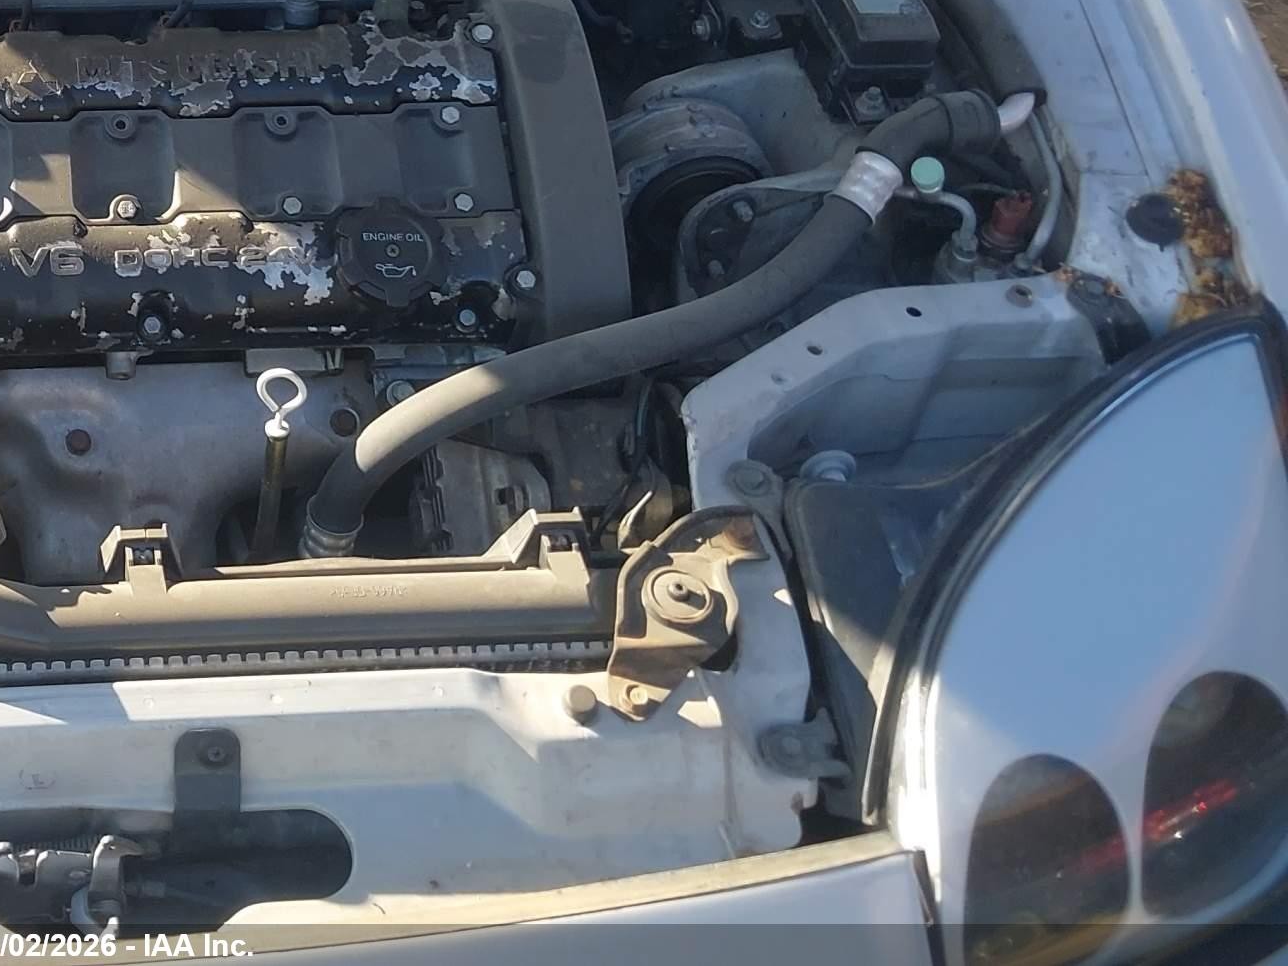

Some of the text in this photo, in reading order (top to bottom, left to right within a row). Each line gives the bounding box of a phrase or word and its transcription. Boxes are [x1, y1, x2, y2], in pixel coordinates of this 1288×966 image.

[74, 52, 324, 85] MITSUBISHI
[362, 232, 424, 242] ENGINE OIL
[8, 247, 85, 277] V6
[113, 246, 231, 277] DOHC
